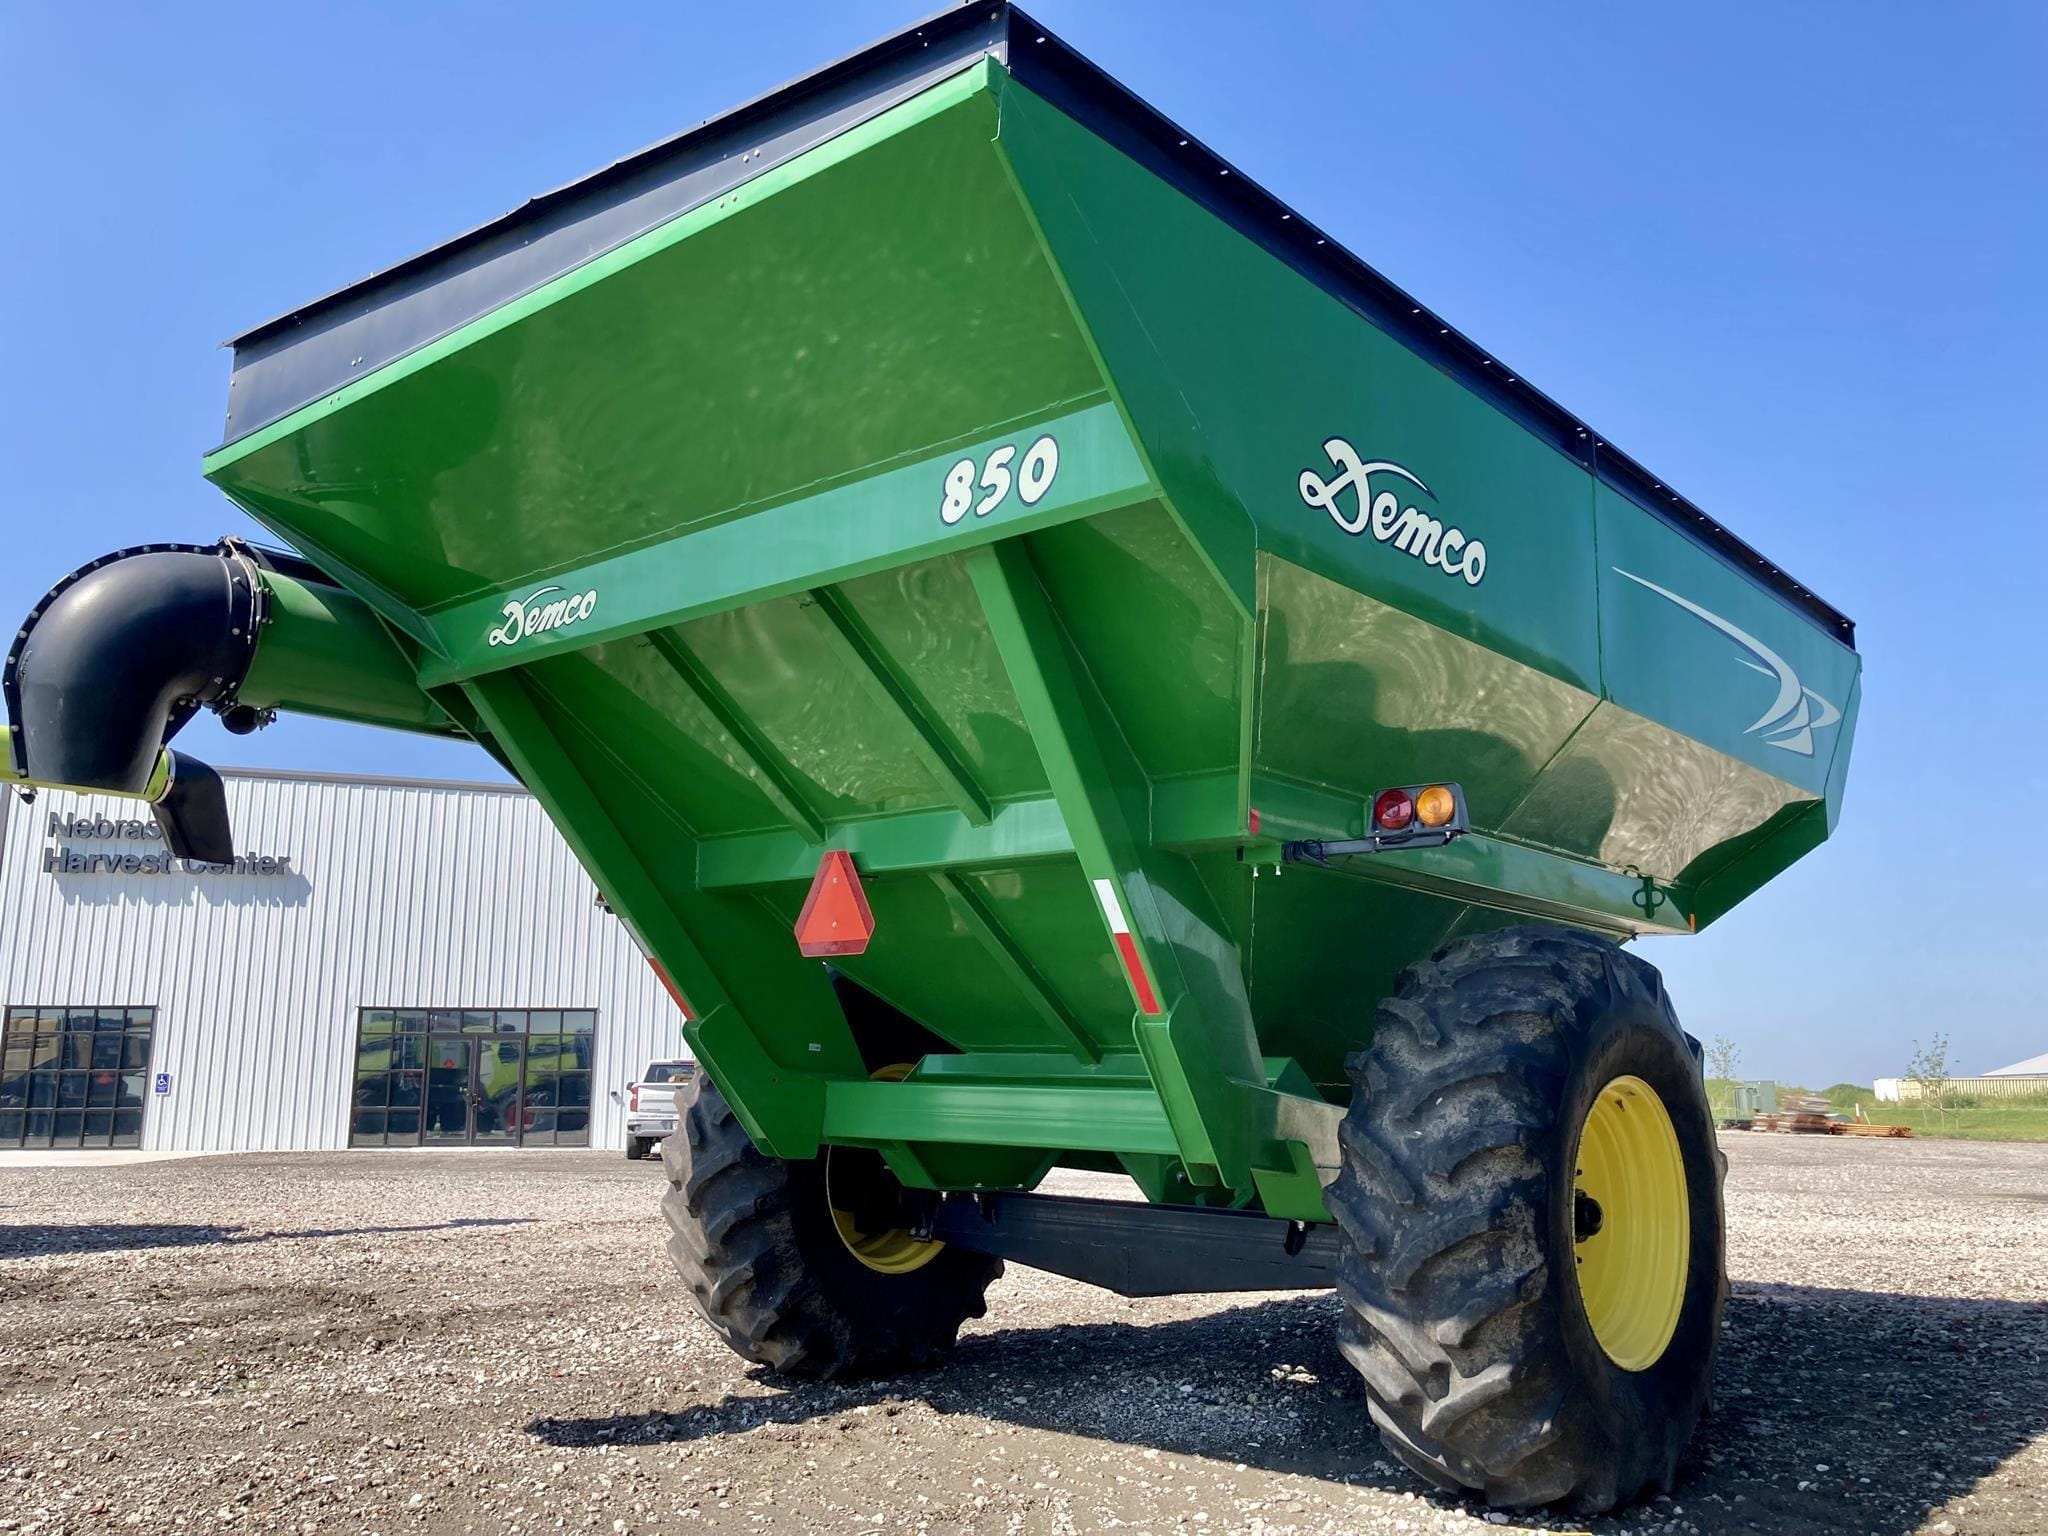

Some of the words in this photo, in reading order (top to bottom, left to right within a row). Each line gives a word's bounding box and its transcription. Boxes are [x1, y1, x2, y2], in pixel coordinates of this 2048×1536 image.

[940, 434, 1059, 526] 850
[1298, 436, 1487, 587] Demco
[488, 586, 597, 646] Demco
[48, 812, 163, 840] Nebras
[43, 848, 171, 875] Harvest
